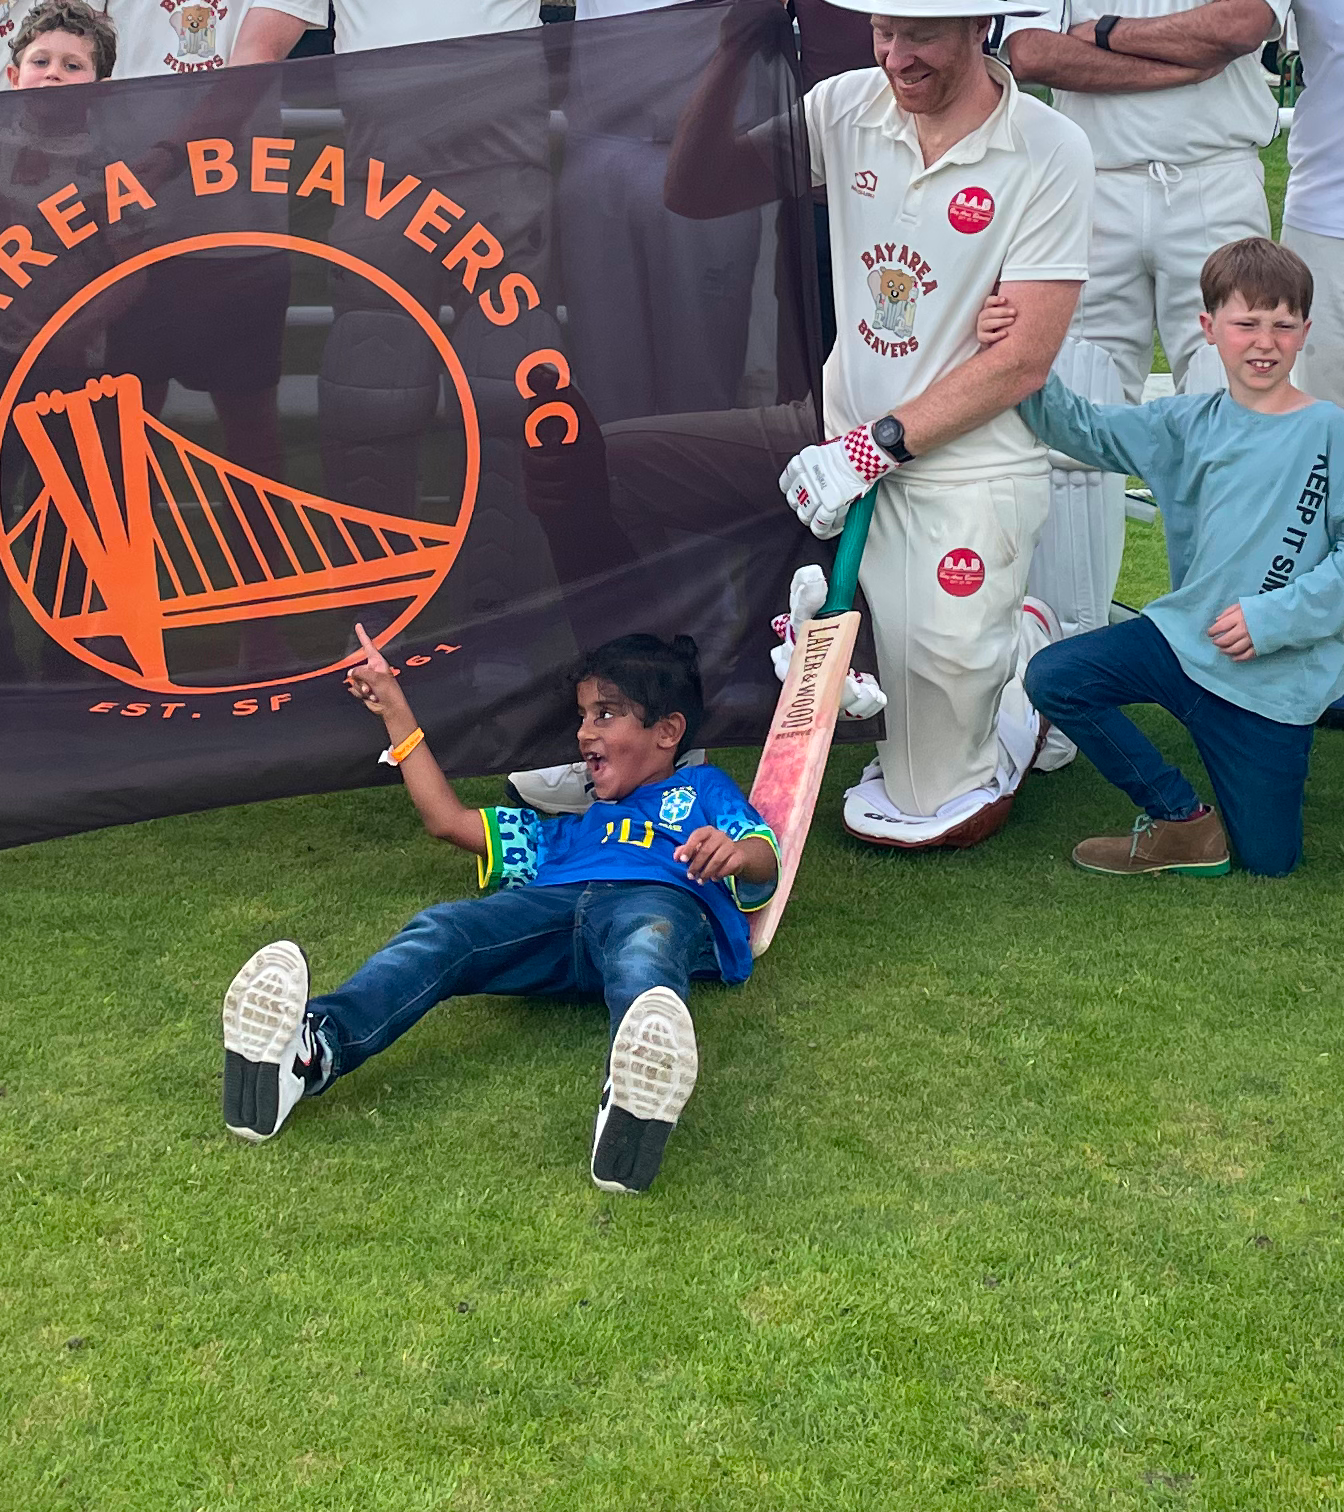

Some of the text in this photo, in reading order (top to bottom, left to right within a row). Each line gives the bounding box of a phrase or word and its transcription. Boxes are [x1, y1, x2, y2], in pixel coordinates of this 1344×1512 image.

[186, 136, 541, 326] BEAVERS
[514, 348, 579, 449] CC
[861, 242, 938, 296] BAY AREA
[858, 318, 919, 358] BEAVERS
[1258, 453, 1329, 595] KEEP IT SIM
[88, 700, 202, 720] EST.
[231, 692, 293, 717] SF
